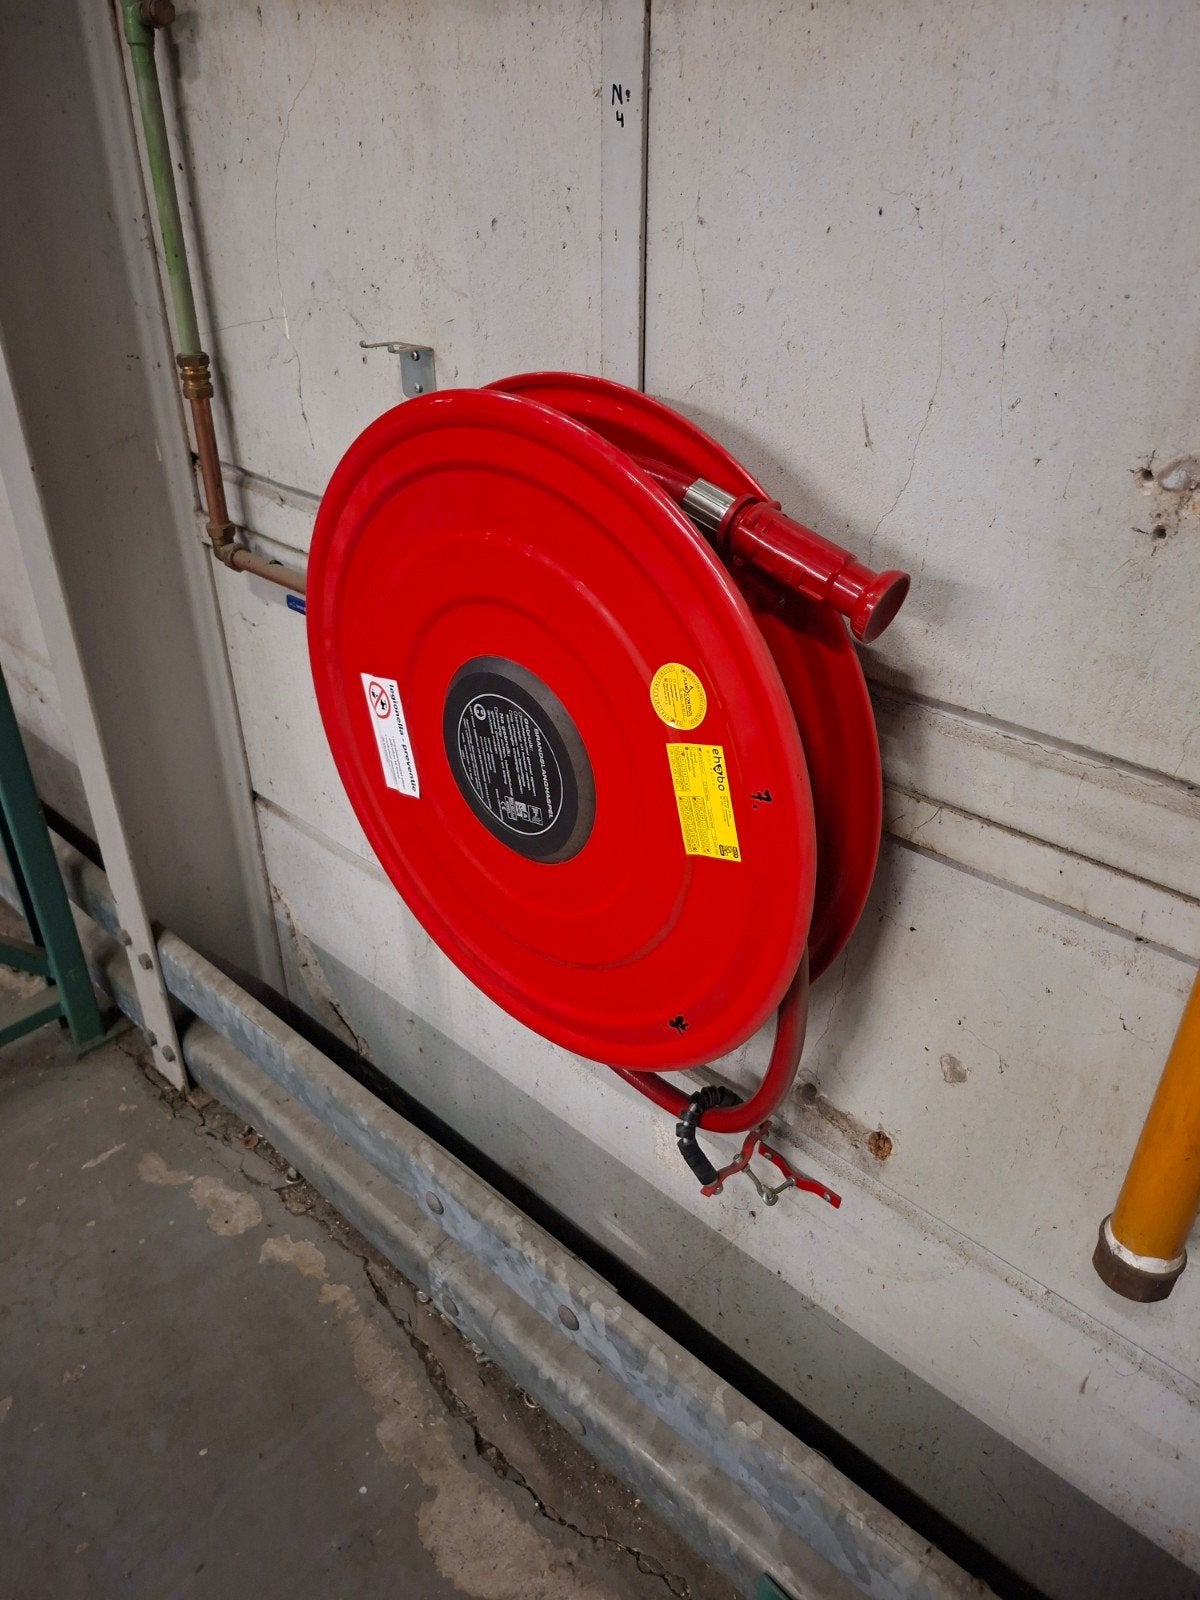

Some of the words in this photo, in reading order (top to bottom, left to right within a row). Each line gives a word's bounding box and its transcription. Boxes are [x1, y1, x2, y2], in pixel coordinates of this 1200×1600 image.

[615, 110, 625, 128] 4
[388, 684, 404, 736] legionella
[401, 744, 416, 792] preventie
[523, 718, 534, 752] Gebruik:
[533, 728, 554, 819] BRANDSLANGHASPEL
